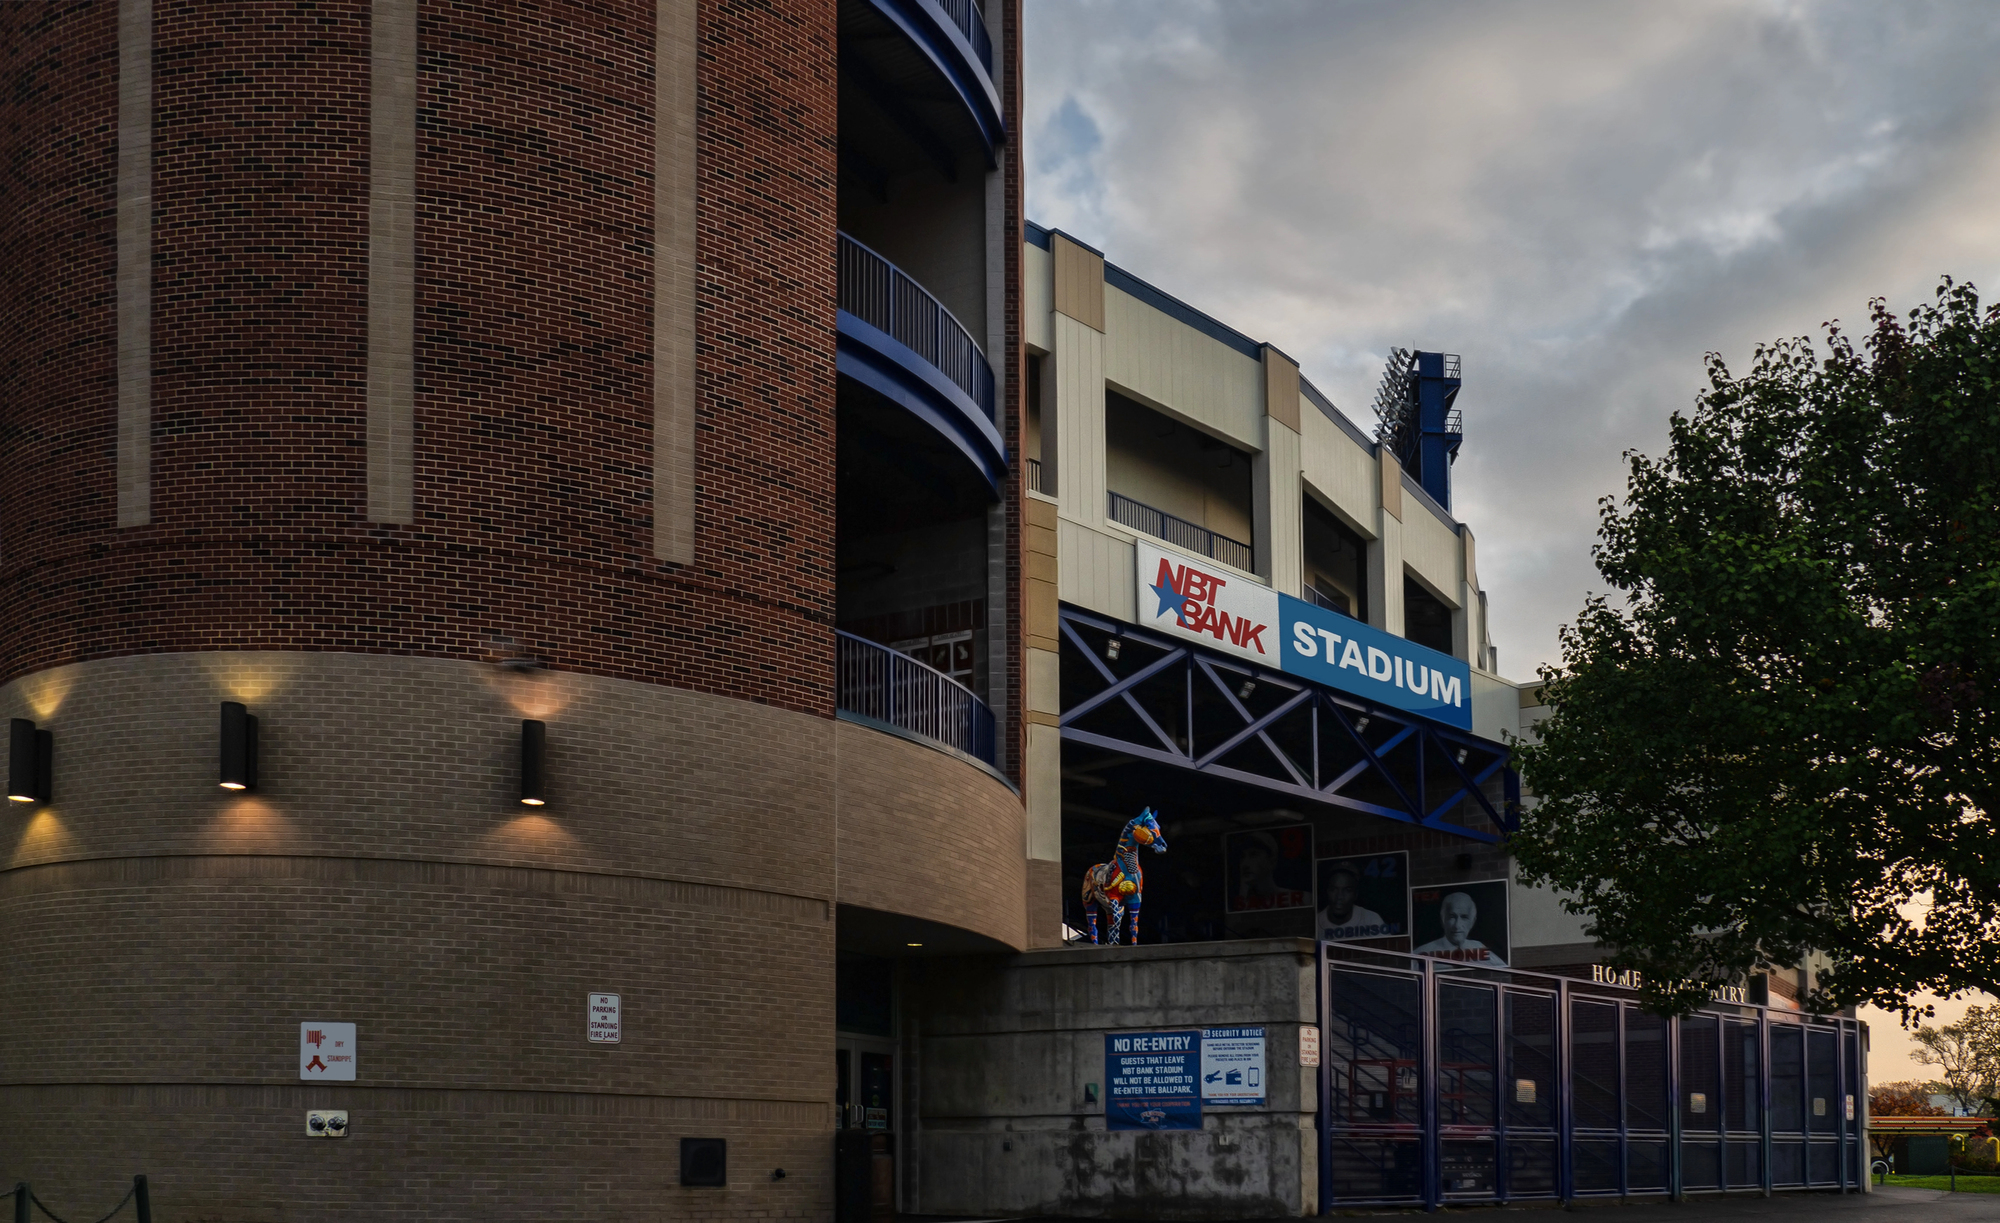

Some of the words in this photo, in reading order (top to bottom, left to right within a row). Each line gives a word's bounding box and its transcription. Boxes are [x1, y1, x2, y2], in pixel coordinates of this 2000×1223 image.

[1156, 557, 1226, 606] NBT
[1176, 599, 1268, 655] BANK
[1293, 621, 1461, 708] STADIUM
[1281, 827, 1305, 859] 9
[1363, 857, 1397, 877] 42
[1233, 891, 1303, 911] SAUER
[1324, 922, 1400, 939] ROBINSON
[1592, 964, 1642, 988] HOME
[604, 1031, 618, 1039] LANE
[1211, 1029, 1240, 1037] SECURITY
[1114, 1038, 1130, 1052] NO
[1133, 1036, 1191, 1051] RE-ENTRY
[1121, 1057, 1145, 1065] GUESTS
[1146, 1056, 1163, 1064] THAT
[1164, 1056, 1185, 1064] LEAVE
[1122, 1067, 1135, 1075] NBT
[1113, 1077, 1128, 1085] WILL
[1143, 1076, 1152, 1084] BE
[1153, 1076, 1182, 1084] ALLOWED
[1184, 1075, 1193, 1083] TO
[1113, 1087, 1143, 1095] RE-ENTER
[1144, 1086, 1157, 1094] THE
[1158, 1085, 1193, 1094] BALLPARK.
